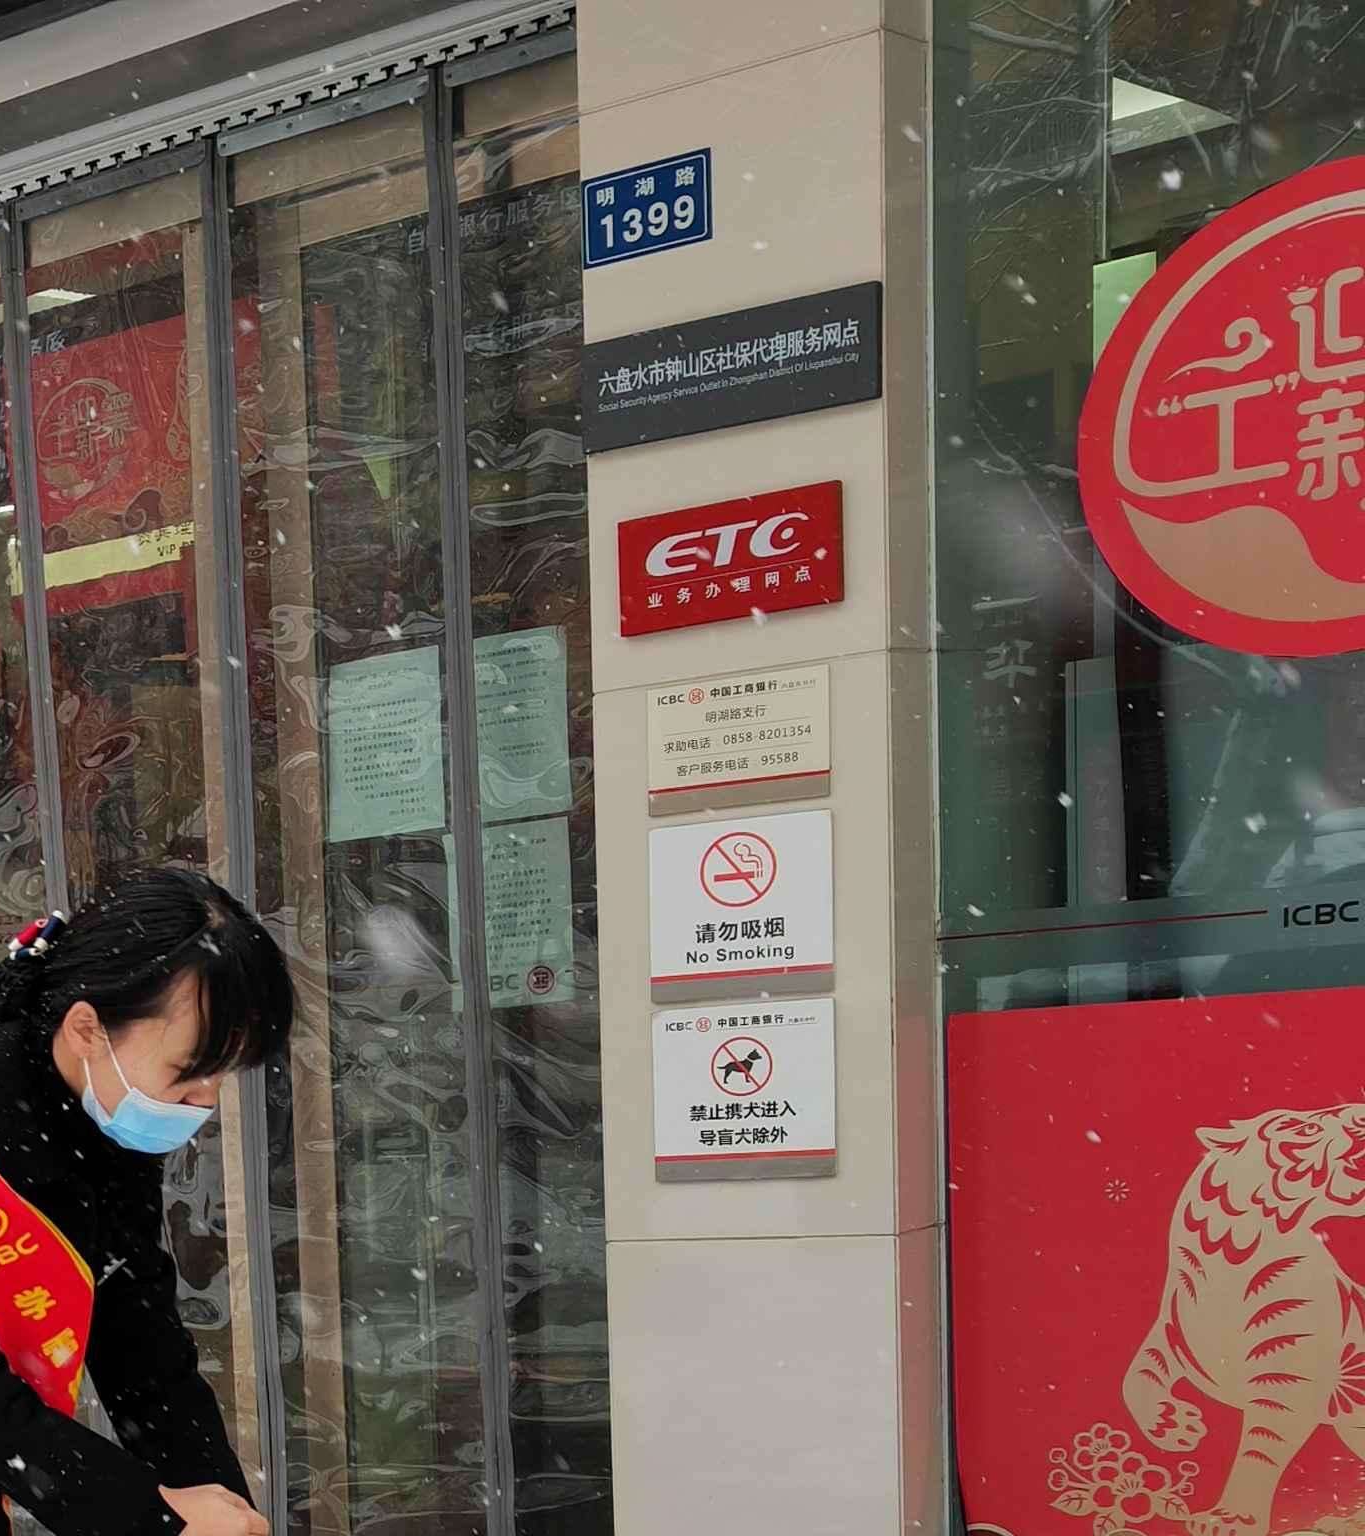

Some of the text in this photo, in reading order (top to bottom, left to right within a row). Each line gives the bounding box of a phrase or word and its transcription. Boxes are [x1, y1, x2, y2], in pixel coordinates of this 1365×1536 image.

[596, 166, 696, 207] 明湖路
[600, 195, 696, 248] 1399
[598, 318, 860, 397] 六盘水市钟山区社保代理服务网点
[645, 511, 810, 578] ETC
[647, 566, 811, 609] 业务办理网点
[656, 693, 686, 706] ICBC
[709, 679, 779, 699] 中国工商银行
[705, 704, 767, 724] 明湖路支行
[663, 736, 712, 754] 求助电话
[676, 751, 800, 777] 客户服务电话 95588
[1283, 901, 1360, 929] ICBC
[694, 916, 786, 944] 请勿吸烟
[685, 944, 796, 965] No Smoking
[665, 1020, 694, 1033] ICBC
[717, 1013, 785, 1029] 中国工商银行
[688, 1100, 797, 1122] 禁止携犬进入
[697, 1125, 789, 1147] 导盲犬除外
